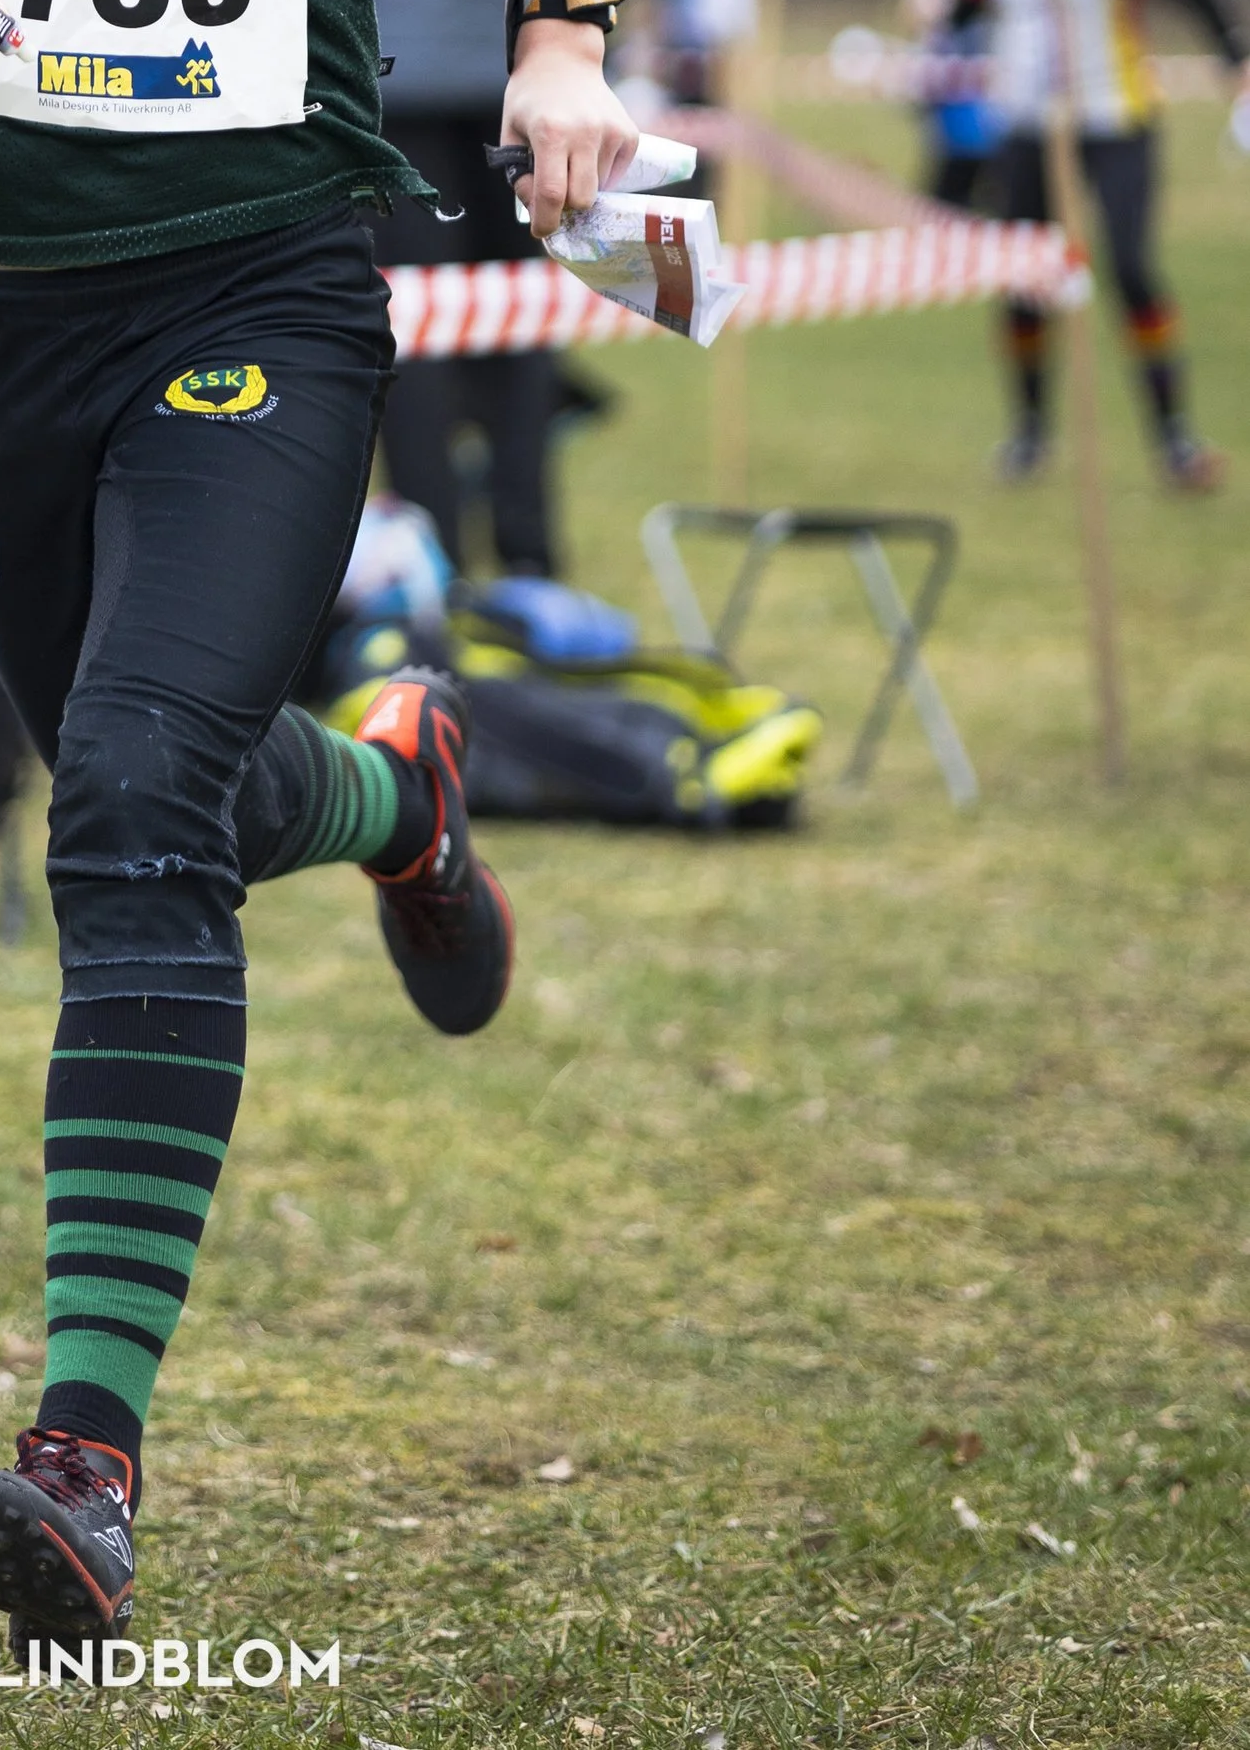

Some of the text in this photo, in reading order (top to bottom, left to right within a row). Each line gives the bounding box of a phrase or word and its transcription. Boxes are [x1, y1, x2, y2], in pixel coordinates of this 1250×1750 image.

[40, 54, 134, 98] Mila
[38, 97, 192, 115] Mila Design & Tillverkning AB
[188, 370, 242, 391] SSK
